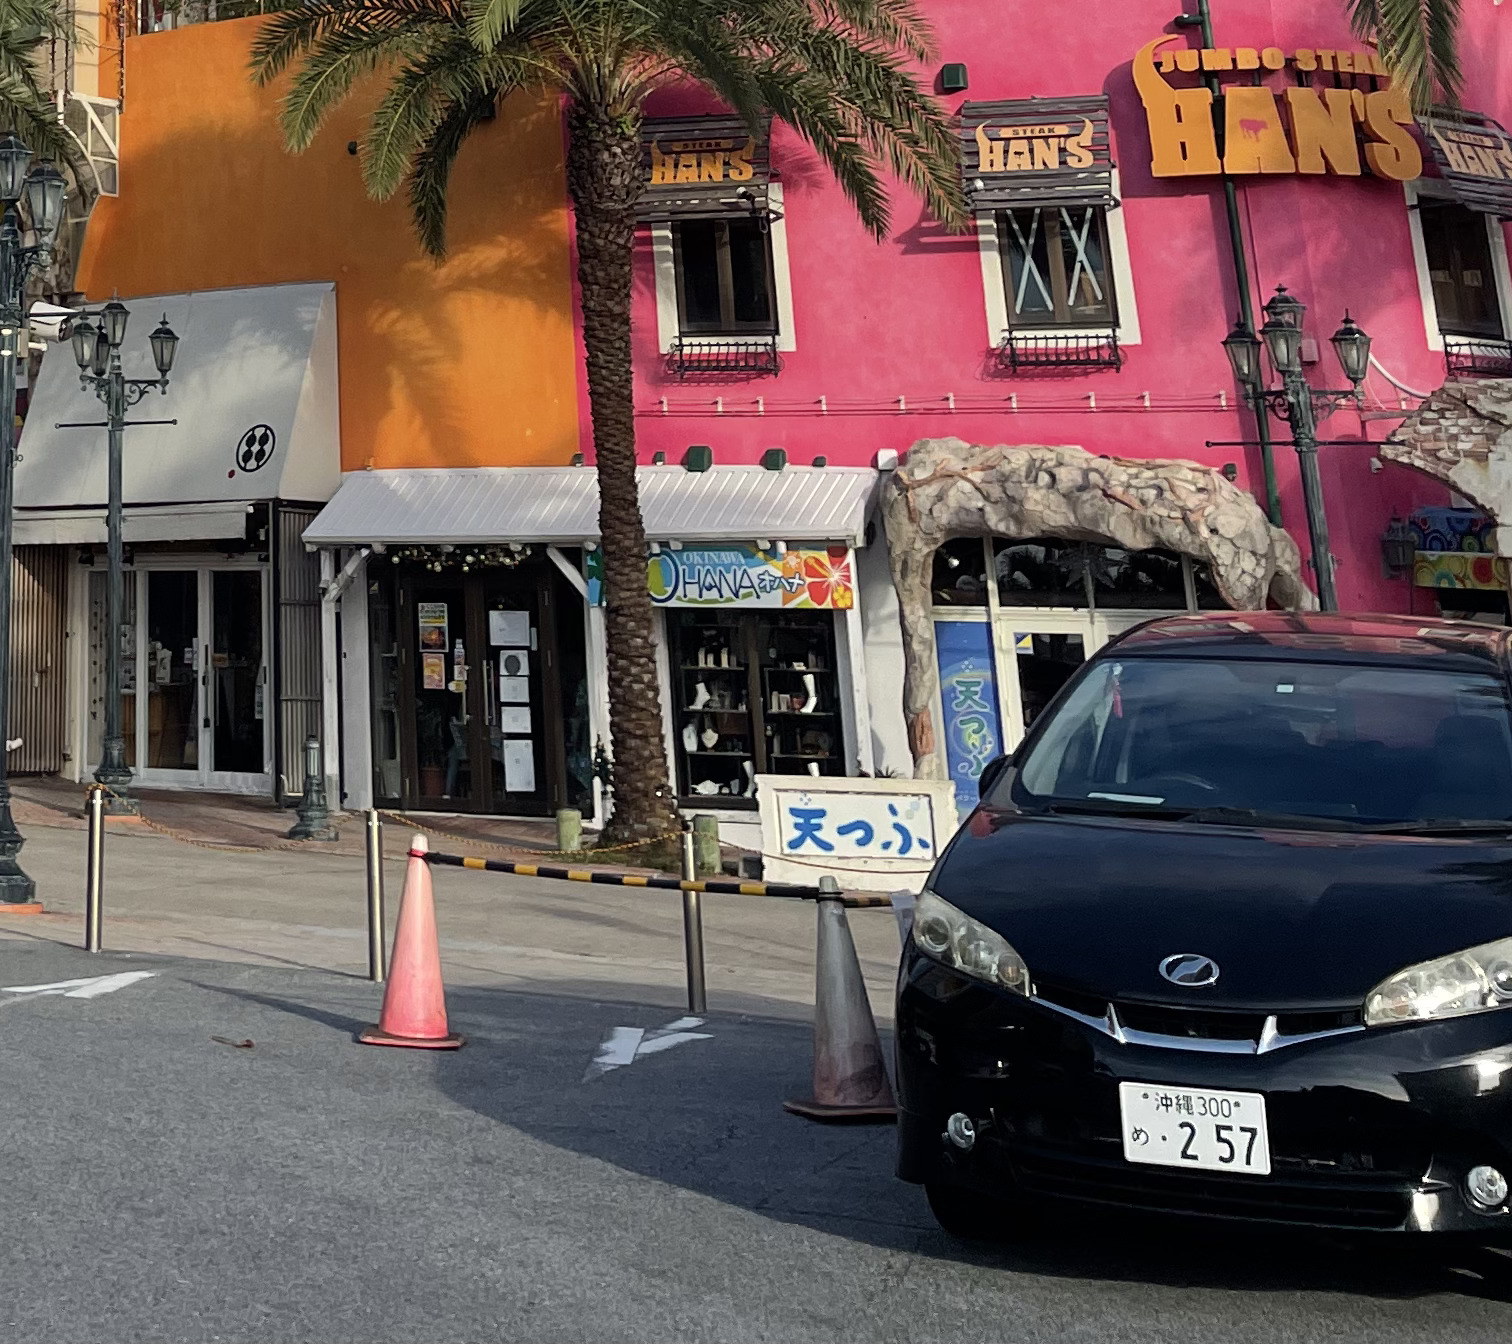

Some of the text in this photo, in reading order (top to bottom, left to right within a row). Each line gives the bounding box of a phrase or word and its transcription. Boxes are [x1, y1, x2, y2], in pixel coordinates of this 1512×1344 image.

[1159, 47, 1286, 73] JUMBO
[1011, 126, 1057, 136] STEAK
[1138, 64, 1423, 181] HAN'S
[650, 147, 755, 185] HAN'S
[975, 130, 1094, 173] HAN'S
[682, 551, 746, 565] OKINAWA
[647, 548, 761, 604] OHANA
[757, 568, 806, 594] オハナ
